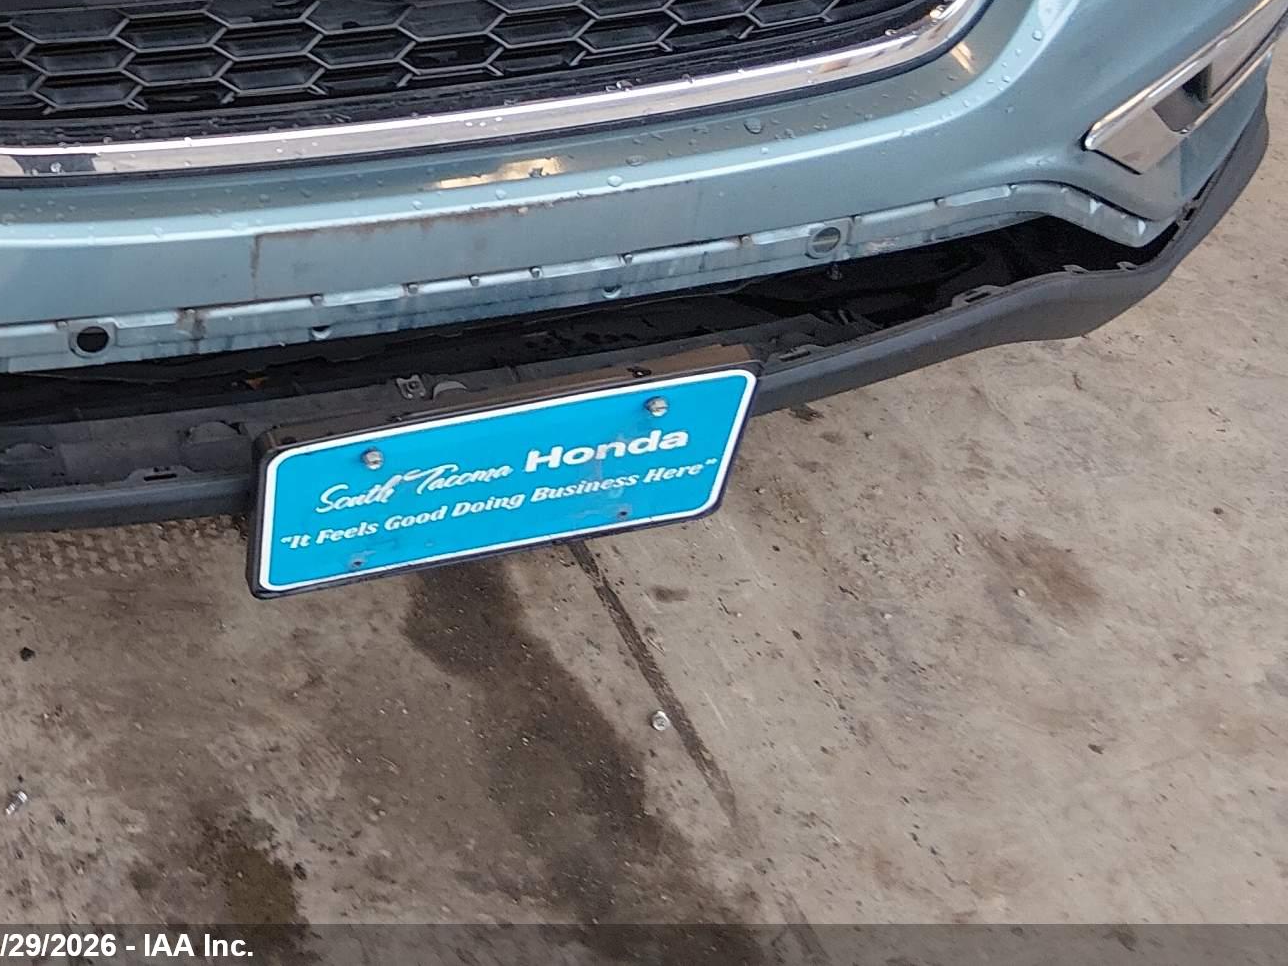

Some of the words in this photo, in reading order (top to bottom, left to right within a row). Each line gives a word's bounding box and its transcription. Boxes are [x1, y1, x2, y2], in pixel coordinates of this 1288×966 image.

[316, 474, 404, 513] South
[403, 464, 513, 494] Tacoma
[524, 430, 689, 472] Honda
[316, 521, 379, 544] Feels
[384, 506, 448, 531] Good
[451, 493, 525, 517] Doing
[530, 474, 640, 502] Business
